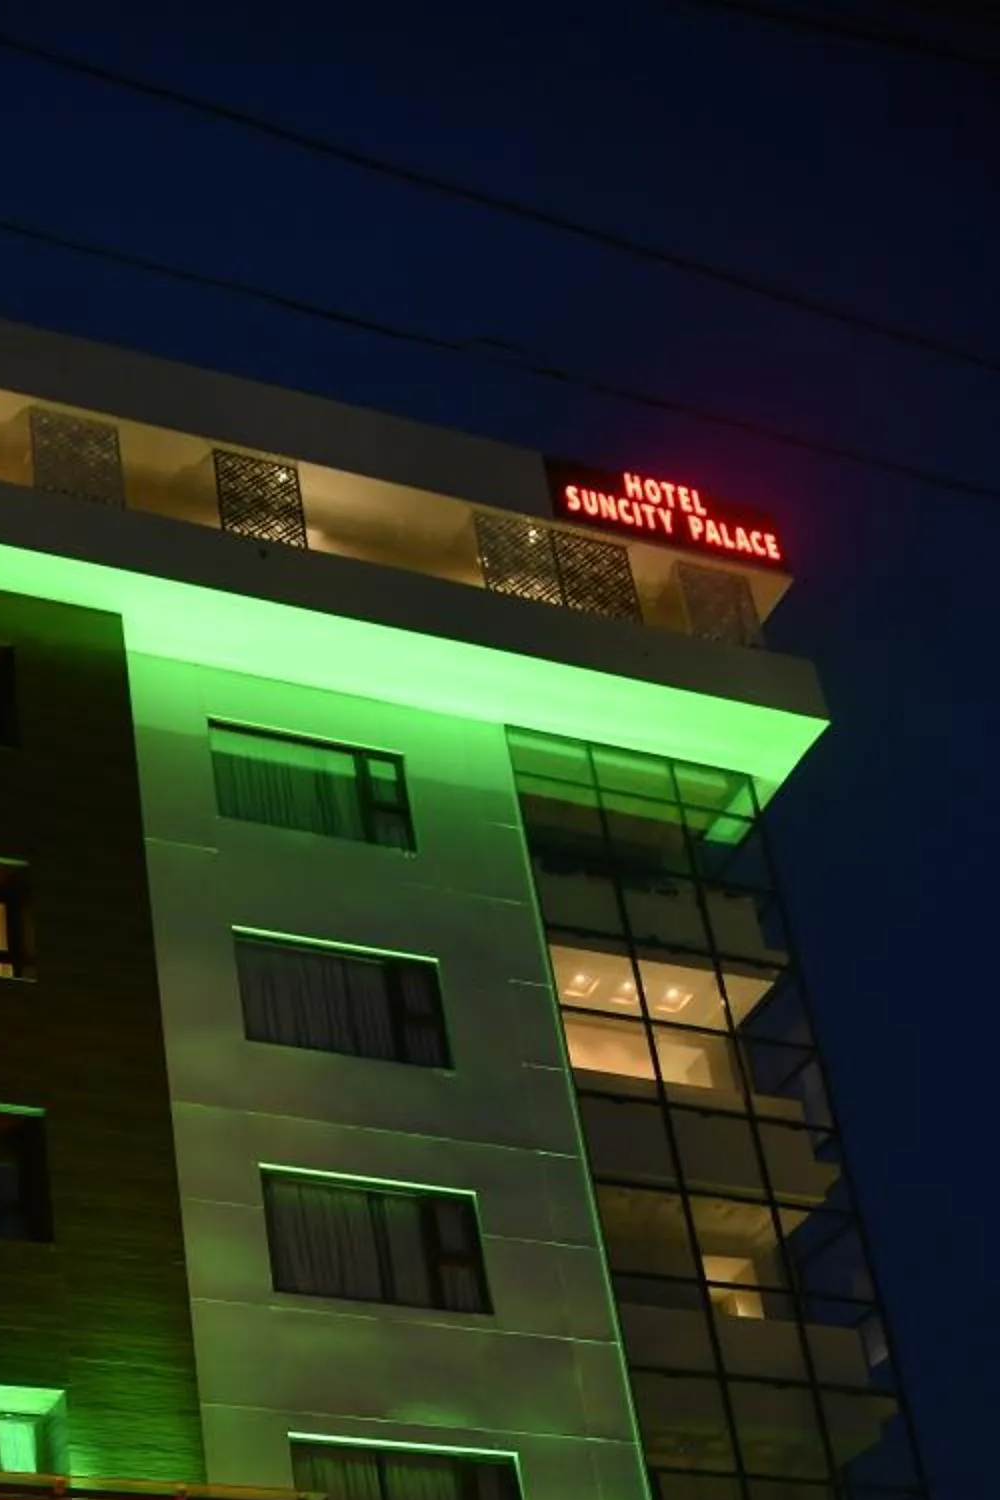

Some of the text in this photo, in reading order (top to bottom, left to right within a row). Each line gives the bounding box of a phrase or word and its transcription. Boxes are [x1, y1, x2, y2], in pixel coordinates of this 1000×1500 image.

[564, 484, 781, 560] SUNCITY PALACE
[623, 471, 707, 515] HOTEL
